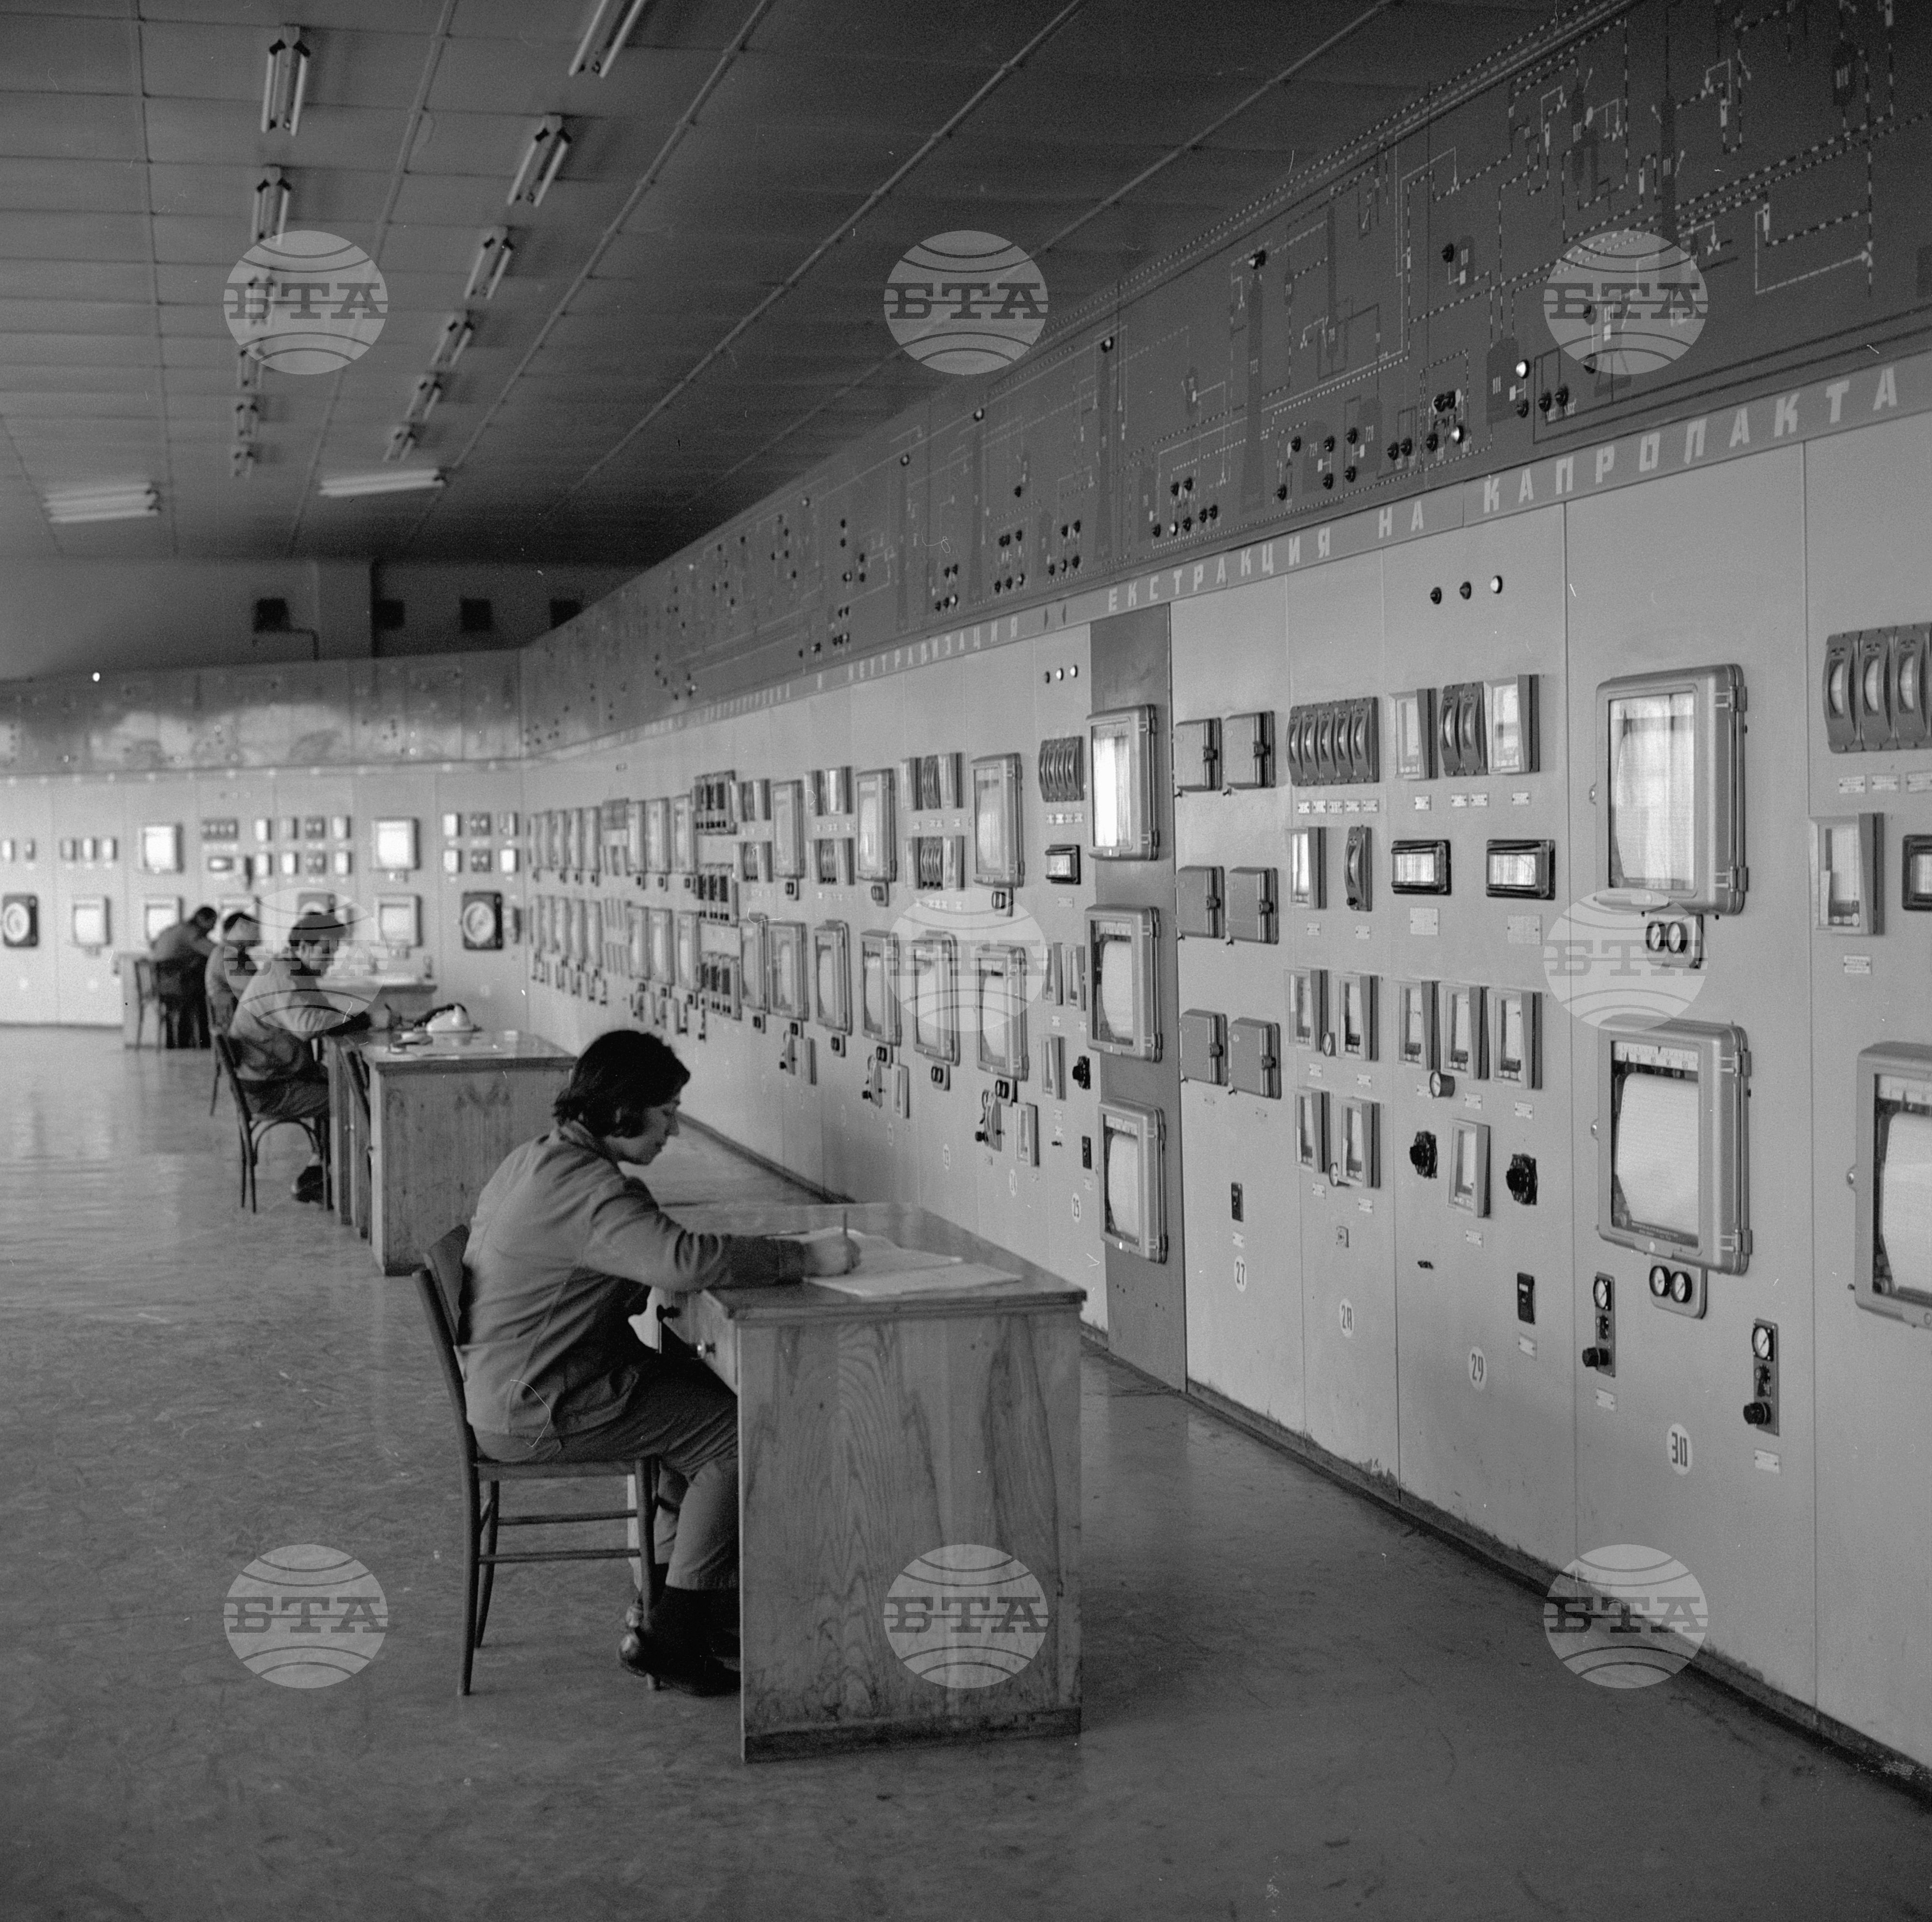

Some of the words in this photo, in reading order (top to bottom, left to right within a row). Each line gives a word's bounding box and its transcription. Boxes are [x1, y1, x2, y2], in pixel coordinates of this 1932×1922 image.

[1108, 527, 1330, 612] ЕКСТРАКЦИЯ
[1378, 501, 1424, 539] НА
[1483, 367, 1897, 513] КАПРОЛАКТА
[1236, 1261, 1245, 1286] 27
[1471, 1353, 1484, 1382] 29
[1672, 1432, 1688, 1467] 30
